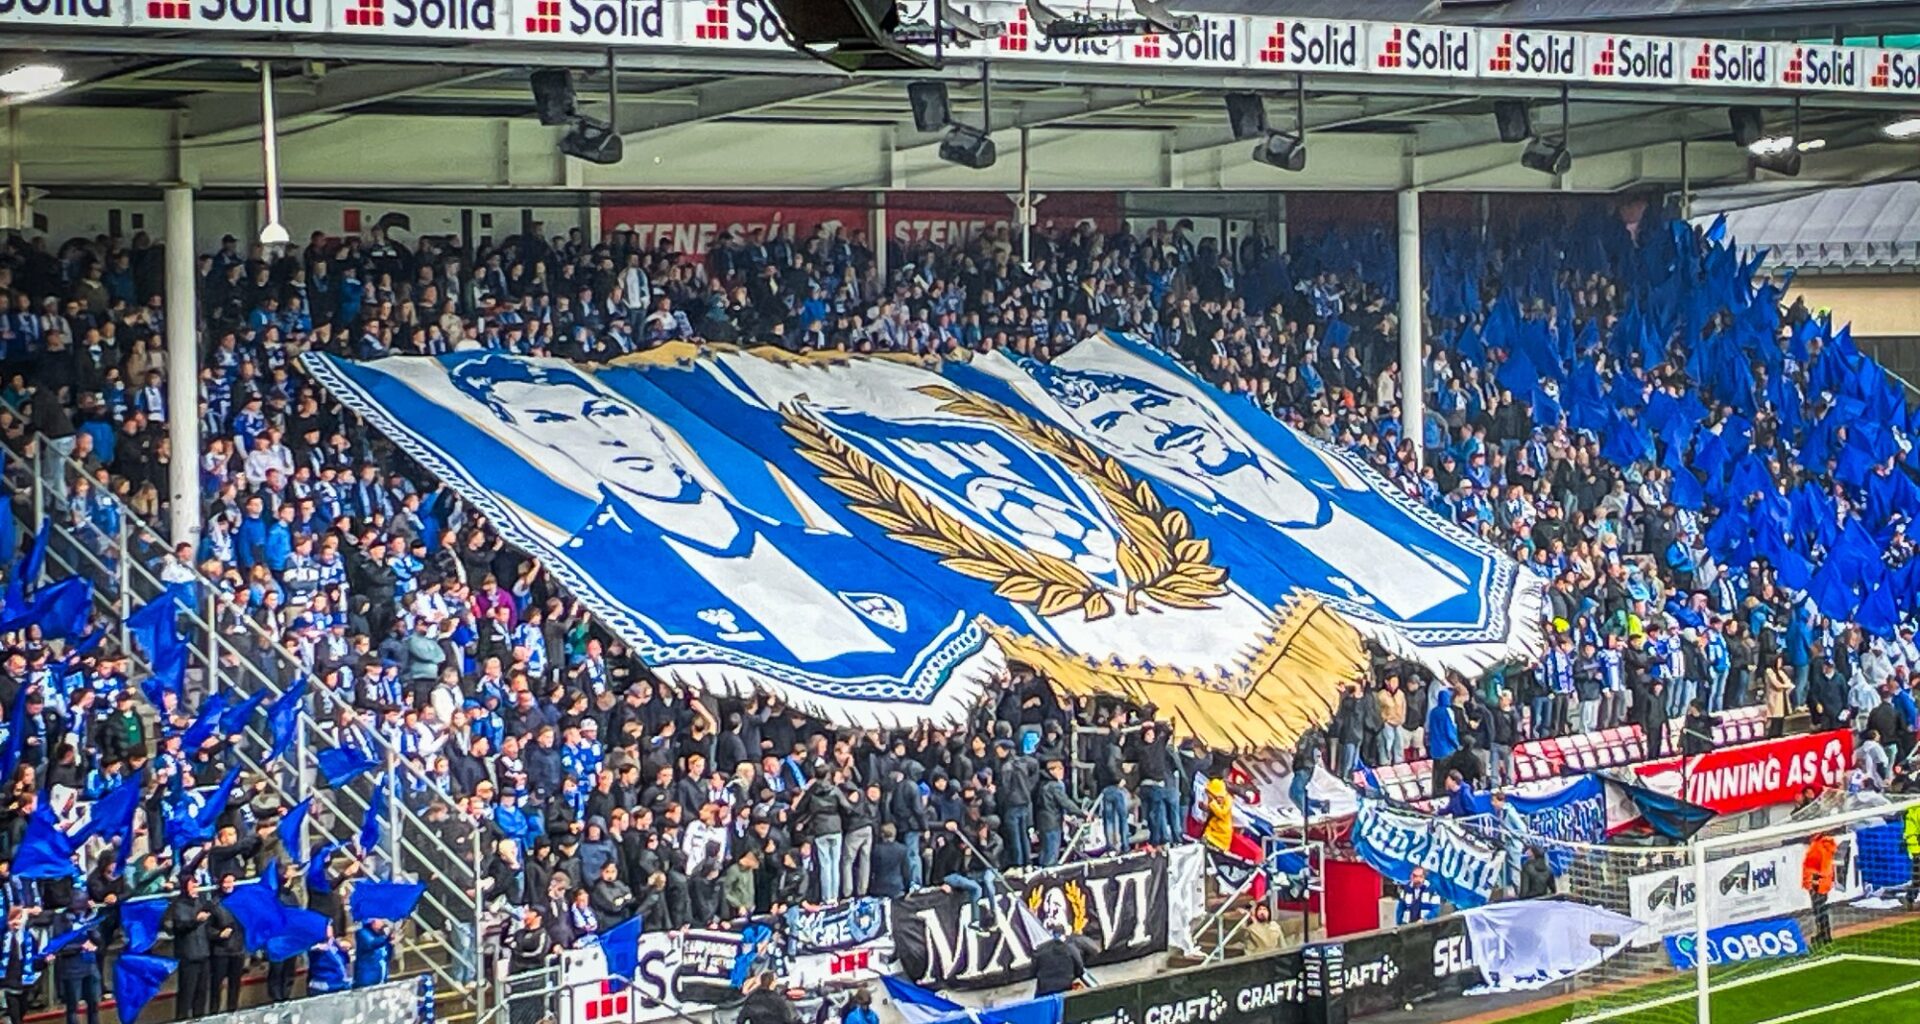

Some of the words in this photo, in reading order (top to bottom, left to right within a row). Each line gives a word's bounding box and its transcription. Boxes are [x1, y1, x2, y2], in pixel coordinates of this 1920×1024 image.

[393, 0, 496, 31] Solid
[570, 0, 664, 38] Solid
[1166, 20, 1236, 61] Solid
[1290, 23, 1356, 66] Solid
[1406, 29, 1468, 71] Solid
[1516, 34, 1575, 74] Solid
[1618, 40, 1672, 78] Solid
[1714, 45, 1766, 81] Solid
[1806, 49, 1855, 86] Solid
[1786, 751, 1818, 787] AS
[1085, 869, 1152, 951] VI
[1722, 929, 1799, 961] OBOS
[1144, 996, 1211, 1024] CRAFT
[1236, 979, 1302, 1012] CRAFT
